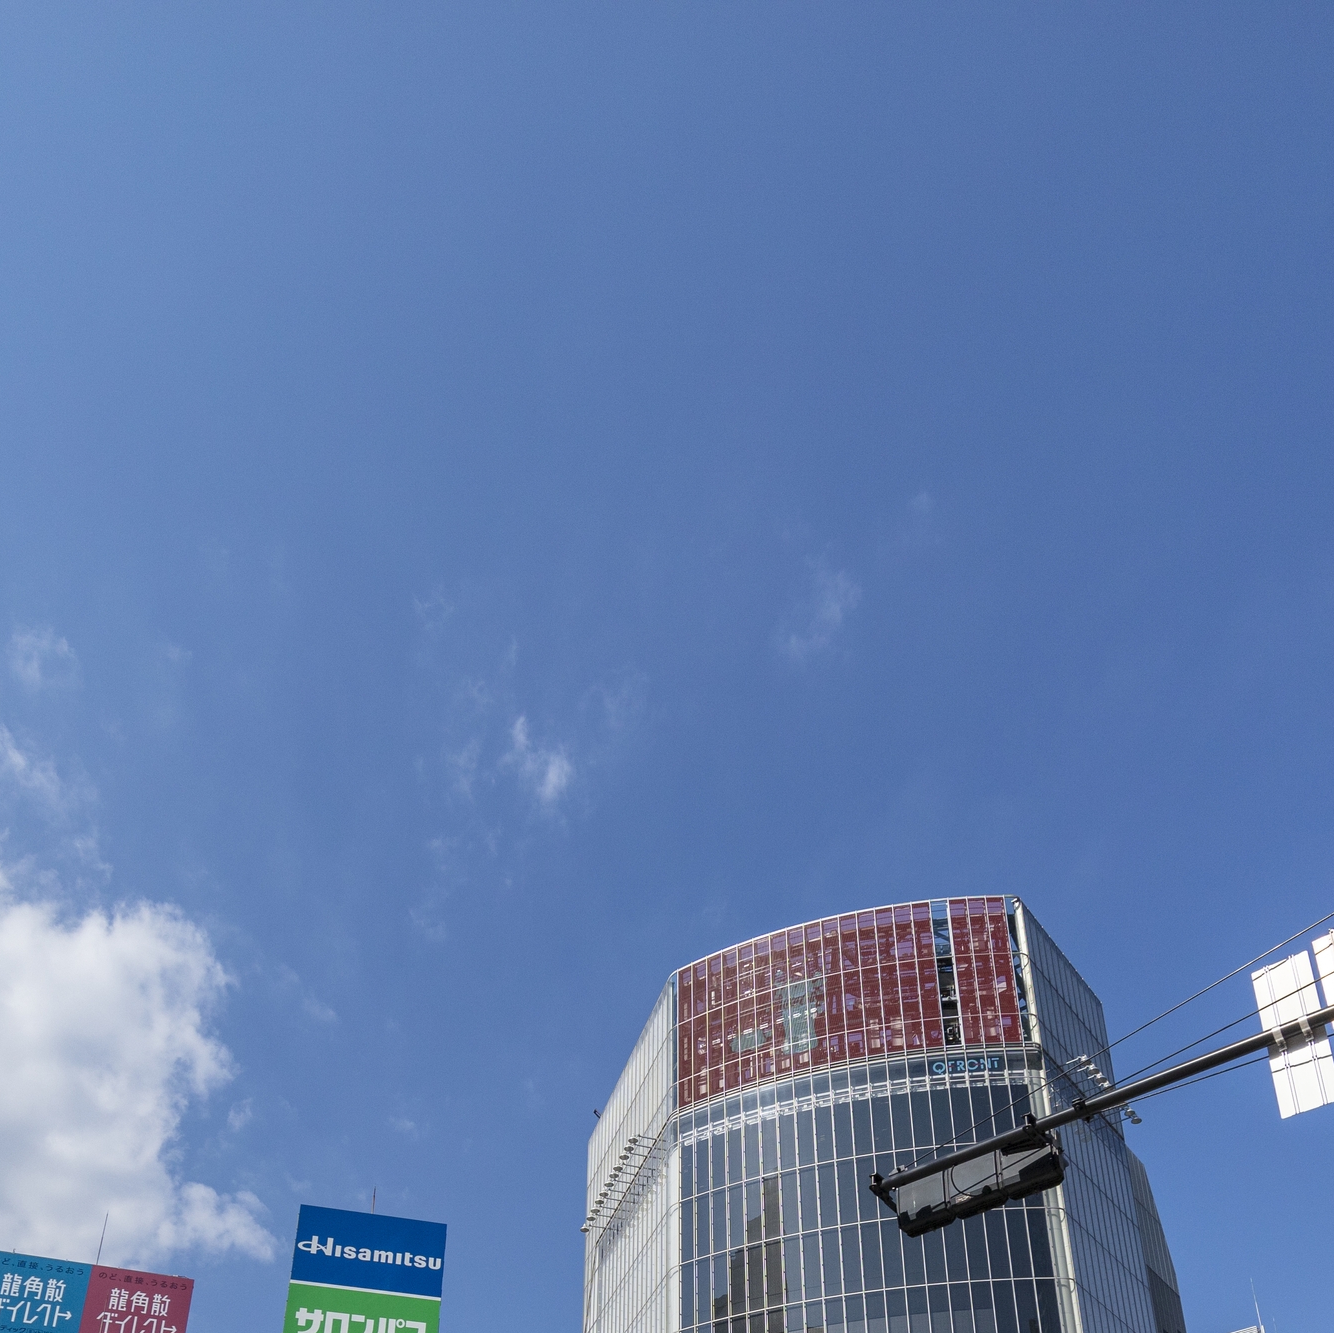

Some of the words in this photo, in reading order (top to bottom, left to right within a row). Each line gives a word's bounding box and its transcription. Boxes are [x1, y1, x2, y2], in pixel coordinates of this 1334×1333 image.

[932, 1057, 1000, 1076] QFRONT
[298, 1235, 441, 1271] Hisamitsu
[0, 1272, 67, 1302] 龍角散
[98, 1270, 188, 1291] のど、直接、うるおう
[108, 1287, 171, 1317] 龍角散
